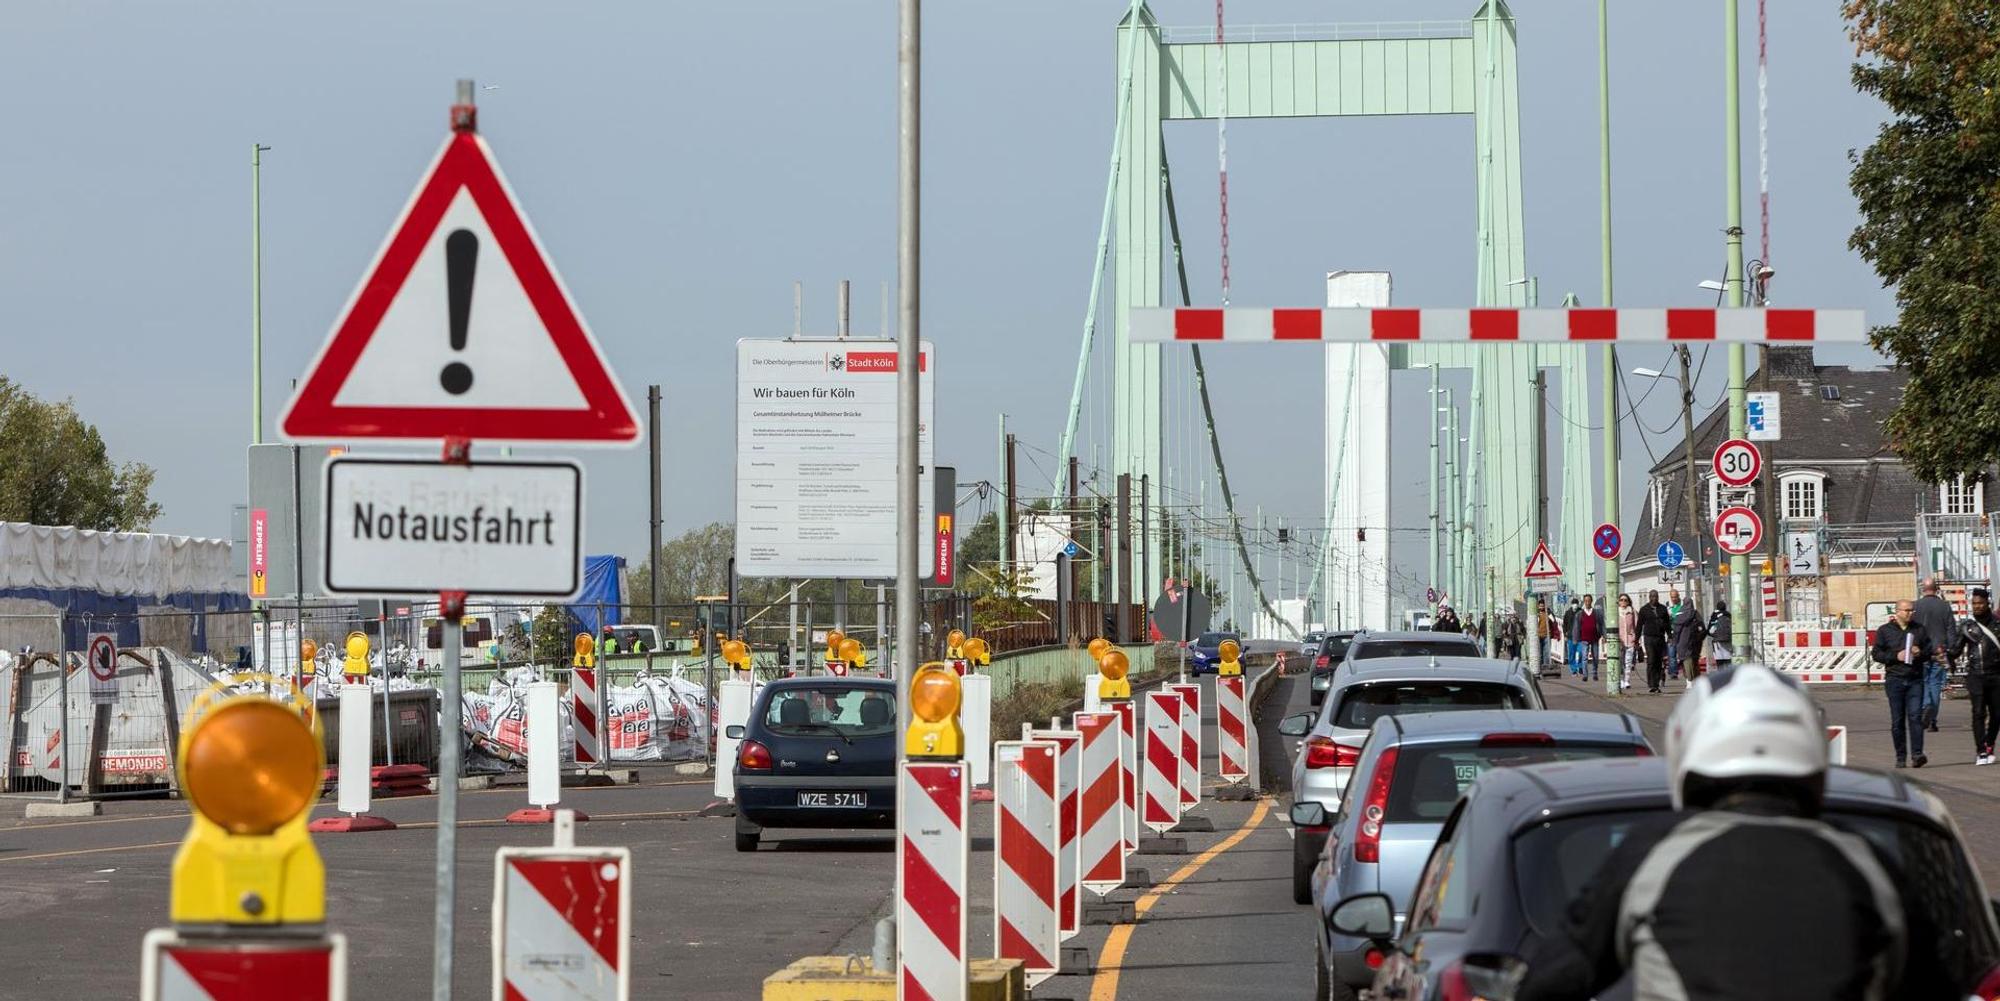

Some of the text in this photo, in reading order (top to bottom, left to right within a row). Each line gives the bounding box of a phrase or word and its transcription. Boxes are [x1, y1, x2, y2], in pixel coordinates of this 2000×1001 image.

[752, 358, 823, 367] Die Oberbürgermeisterin
[848, 357, 894, 367] Stadt Köln
[753, 386, 855, 398] Wir bauen für Köln
[1724, 452, 1750, 473] 30
[353, 500, 554, 545] Notausfahrt
[940, 538, 948, 577] ZEPPELIN
[101, 757, 164, 770] REMONDIS
[800, 793, 865, 806] WZE 571L
